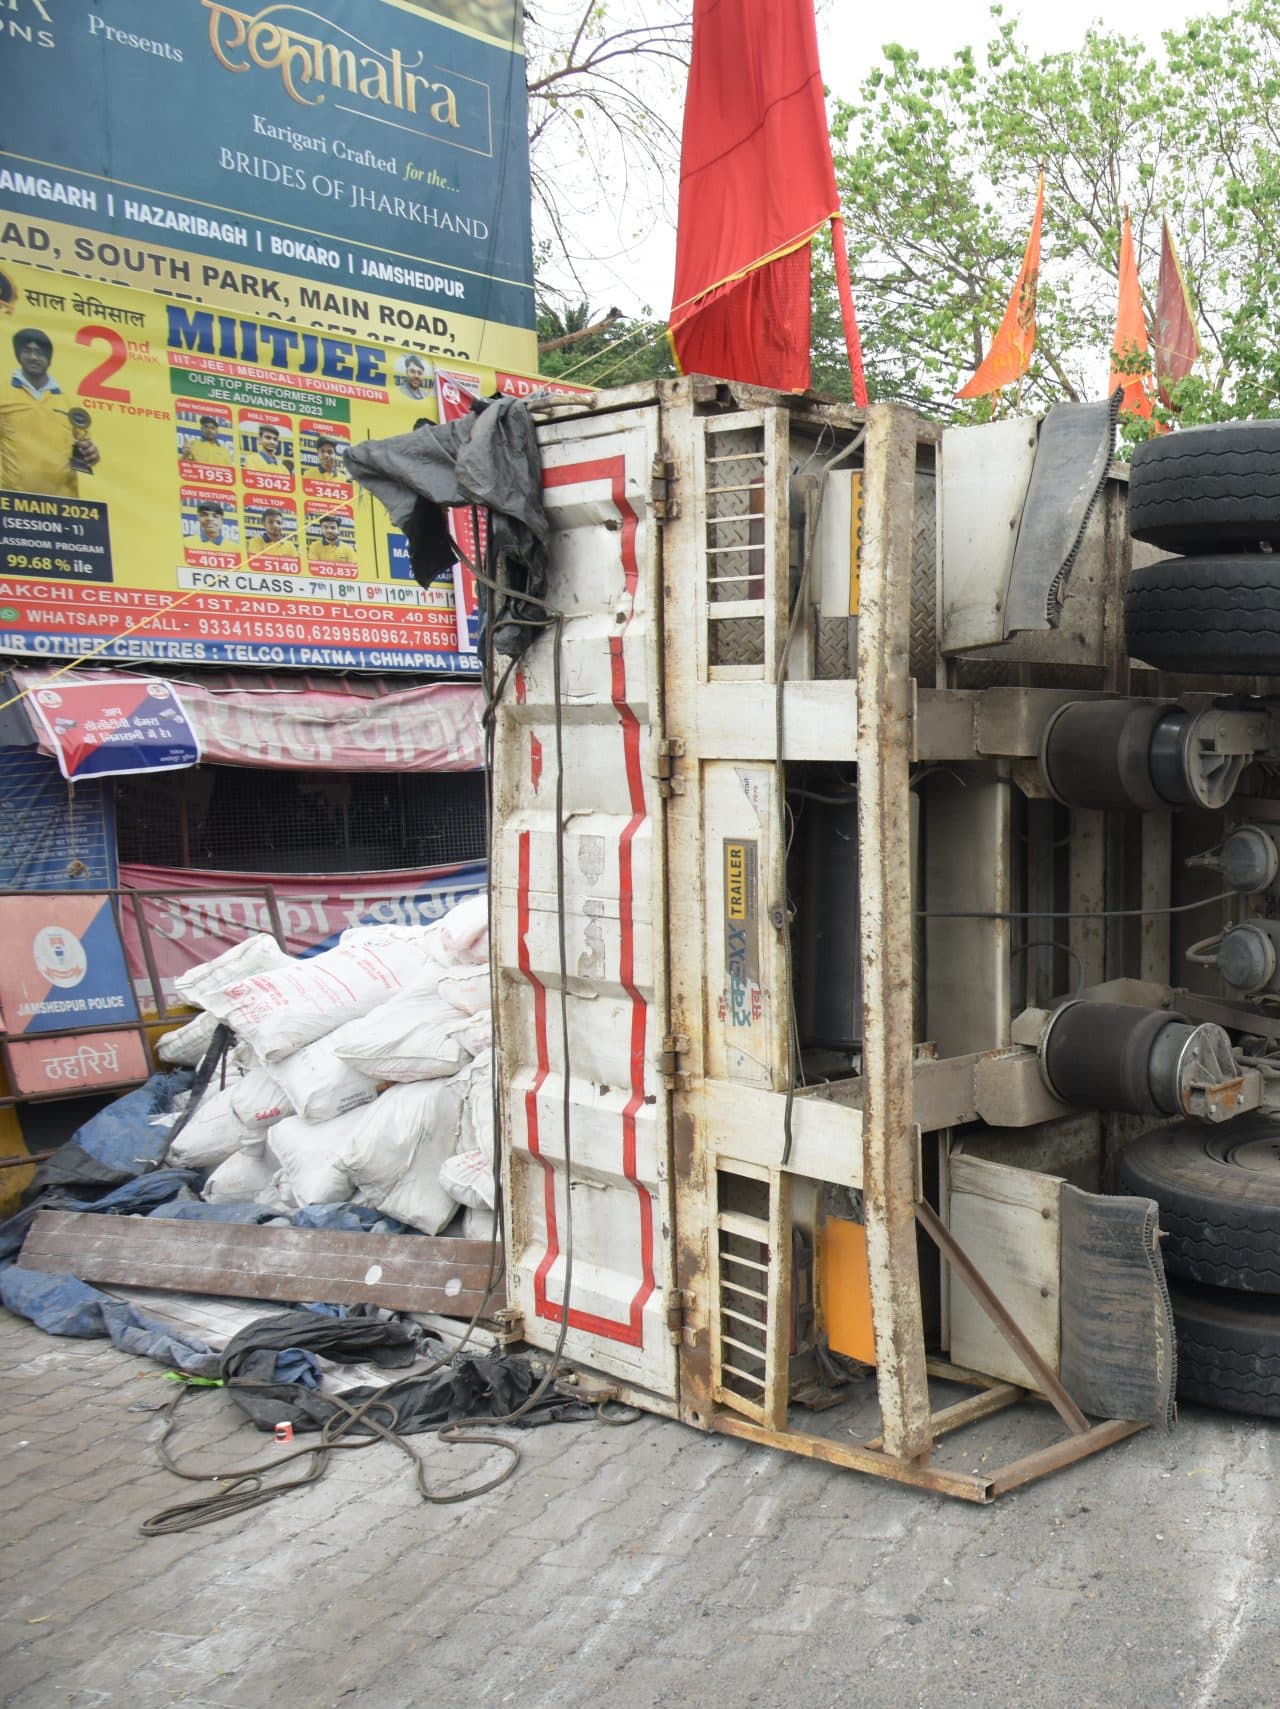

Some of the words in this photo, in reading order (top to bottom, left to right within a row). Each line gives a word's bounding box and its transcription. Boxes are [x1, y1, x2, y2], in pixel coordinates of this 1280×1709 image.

[87, 13, 184, 63] Presents
[252, 114, 329, 154] Karigari
[332, 140, 397, 175] Crafted
[402, 162, 424, 181] for
[218, 147, 306, 191] BRIDES
[311, 175, 344, 201] OF
[349, 184, 489, 240] JHARKHAND
[124, 199, 248, 247] HAZARIBAGH
[270, 235, 341, 269] BOKARO
[360, 258, 465, 300] JAMSHEDPUR
[74, 237, 191, 283] SOUTH
[202, 264, 290, 308] PARK,
[299, 286, 370, 321] MAIN
[379, 304, 456, 343] ROAD,
[25, 288, 66, 312] साल
[71, 292, 146, 328] बेमिसाल
[166, 304, 387, 387] MIITJEE
[188, 372, 216, 388] OUR
[219, 377, 242, 391] TOP
[245, 381, 323, 404] PERFORMERS
[325, 396, 337, 408] IN
[200, 359, 225, 373] JEE
[237, 364, 295, 386] MEDICAL
[306, 378, 383, 401] FOUNDATION
[82, 400, 115, 412] CITY
[119, 404, 171, 421] TOPPER
[208, 388, 231, 402] JEE
[232, 391, 297, 413] ADVANCED
[298, 402, 324, 418] 2023
[197, 469, 233, 483] 1953
[256, 477, 291, 491] 3042
[315, 486, 349, 501] 3445
[14, 498, 58, 516] MAIN
[61, 504, 99, 520] 2024
[2, 516, 62, 533] (SESSION
[0, 537, 52, 550] ASSROOM
[55, 542, 104, 554] PROGRAM
[7, 554, 52, 571] 99.68
[54, 558, 71, 572] %
[73, 559, 93, 574] ile
[199, 556, 236, 568] 4012
[264, 561, 299, 573] 5140
[318, 565, 358, 577] 20,837
[191, 572, 230, 589] FOR
[235, 574, 294, 594] CLASS
[309, 580, 327, 596] 7th
[338, 584, 355, 598] 8th
[366, 586, 383, 600] 9th
[27, 609, 119, 627] WHATSAPP
[124, 615, 135, 627] &
[81, 590, 174, 607] CENTER
[195, 597, 325, 616] 1ST,2ND,3RD
[331, 607, 395, 621] FLOOR
[34, 635, 107, 654] OTHER
[113, 639, 206, 659] CENTRES
[224, 644, 284, 661] TELCO
[301, 648, 357, 665] PATNA
[369, 651, 447, 669] CHHAPRA
[730, 848, 742, 916] TRAILER
[17, 997, 88, 1017] JAMSHEDPUR
[88, 995, 125, 1010] POLICE
